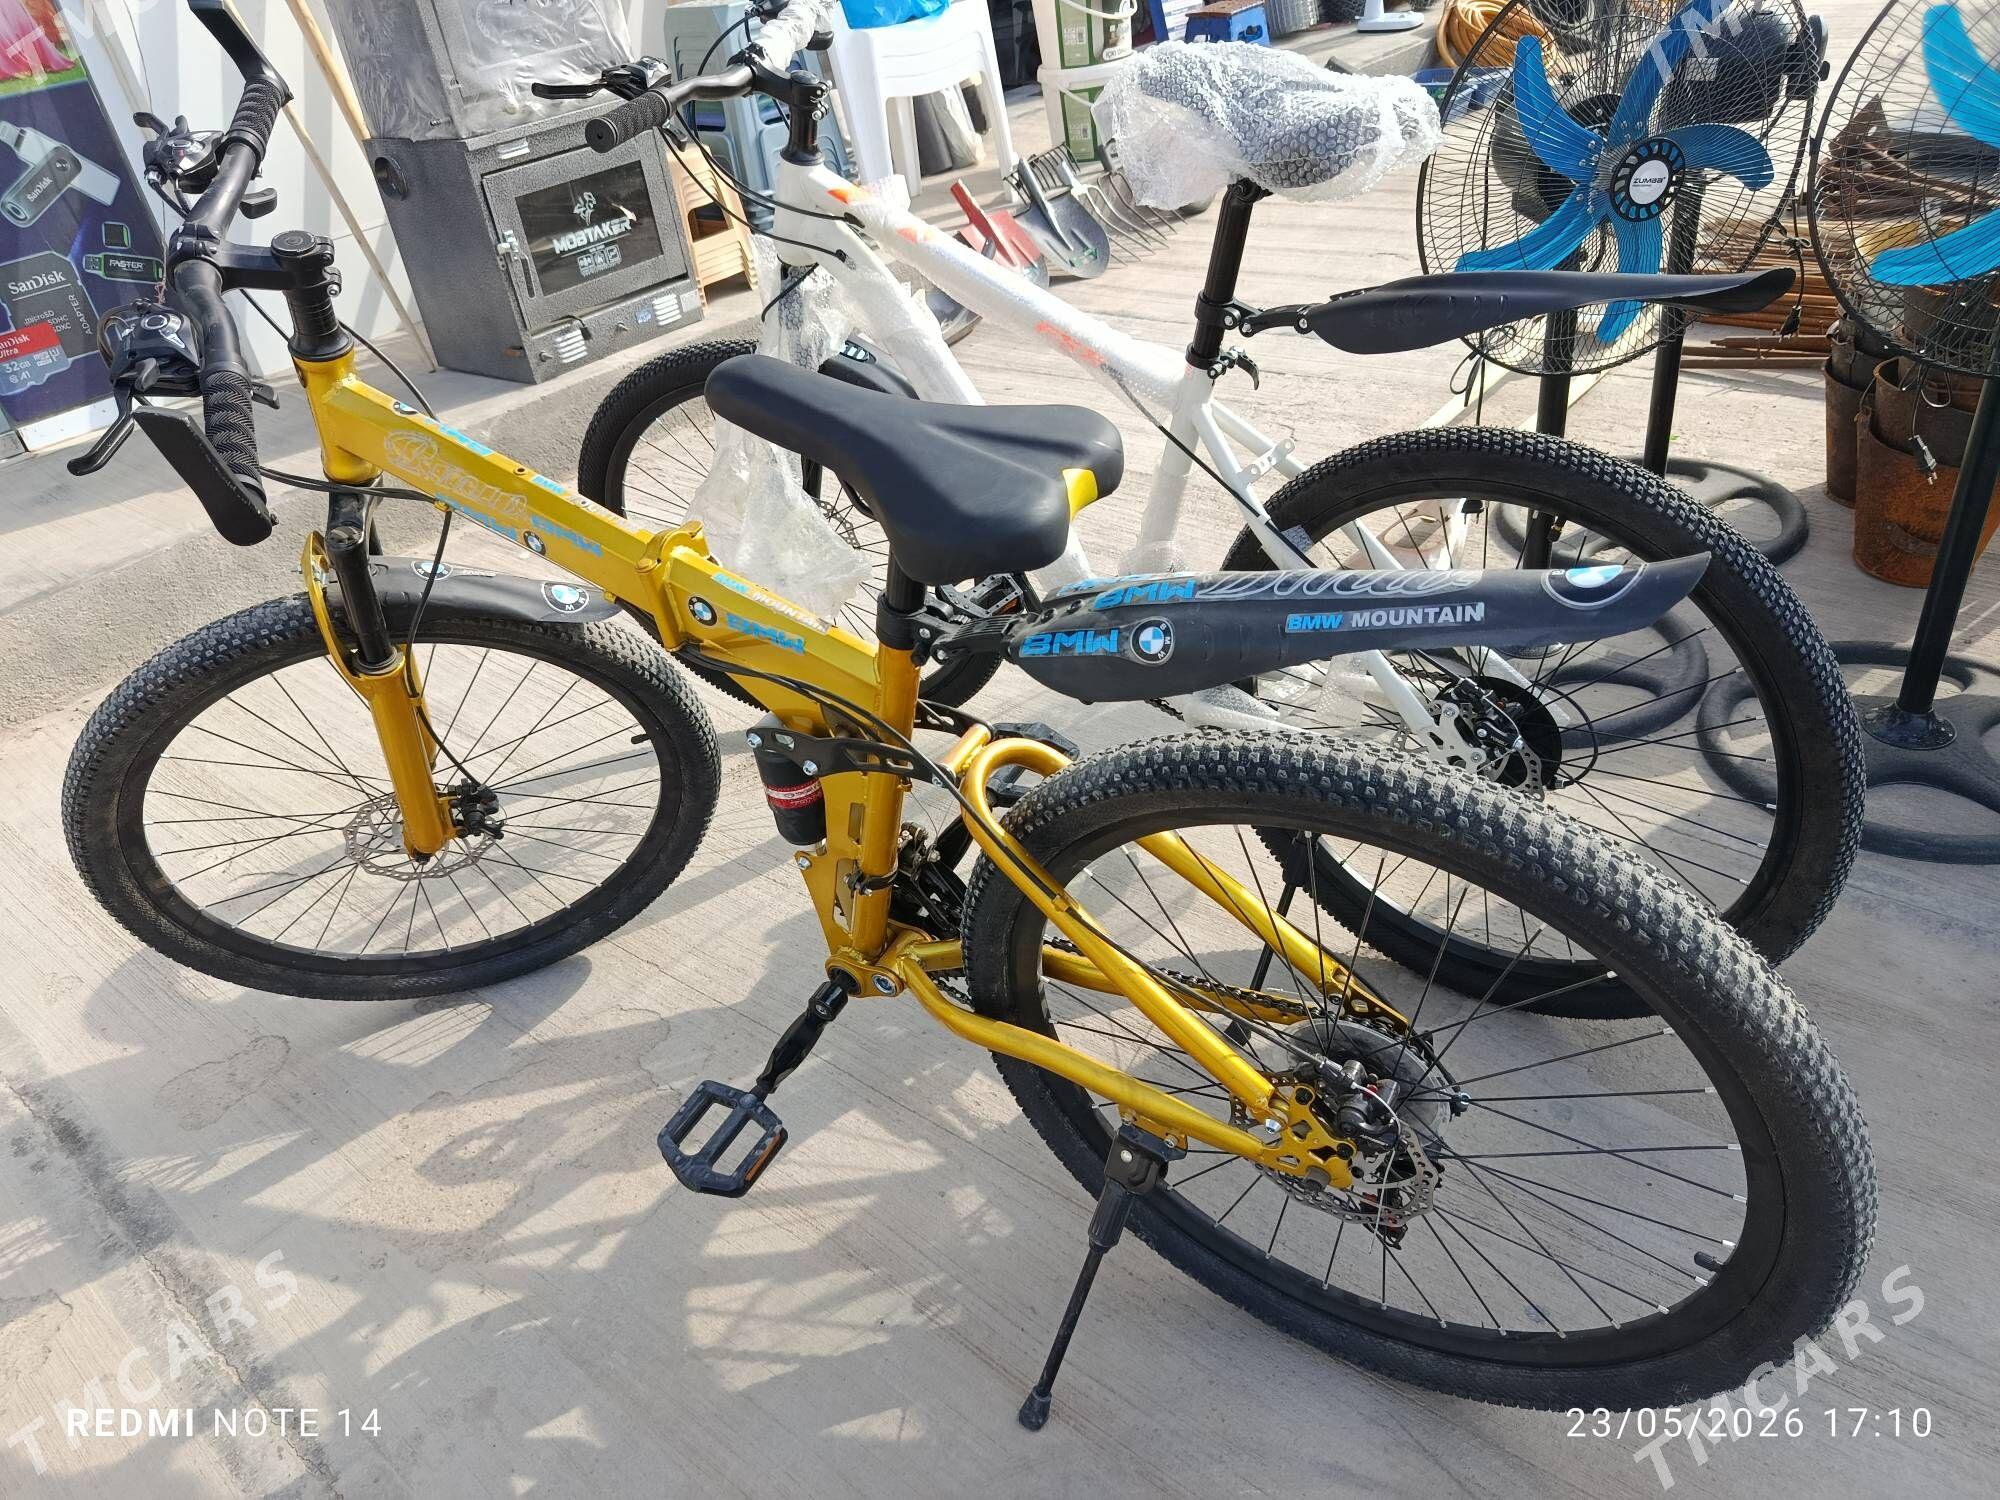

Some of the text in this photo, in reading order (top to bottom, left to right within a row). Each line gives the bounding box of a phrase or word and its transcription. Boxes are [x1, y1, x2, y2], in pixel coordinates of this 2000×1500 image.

[27, 176, 54, 203] SanDisk
[109, 259, 145, 270] FASTER
[8, 270, 67, 295] SanDisk
[68, 294, 93, 335] ADAPTER
[1093, 579, 1197, 610] BMW
[1287, 602, 1484, 631] BMW MOUNTAIN
[1020, 628, 1120, 656] BMW
